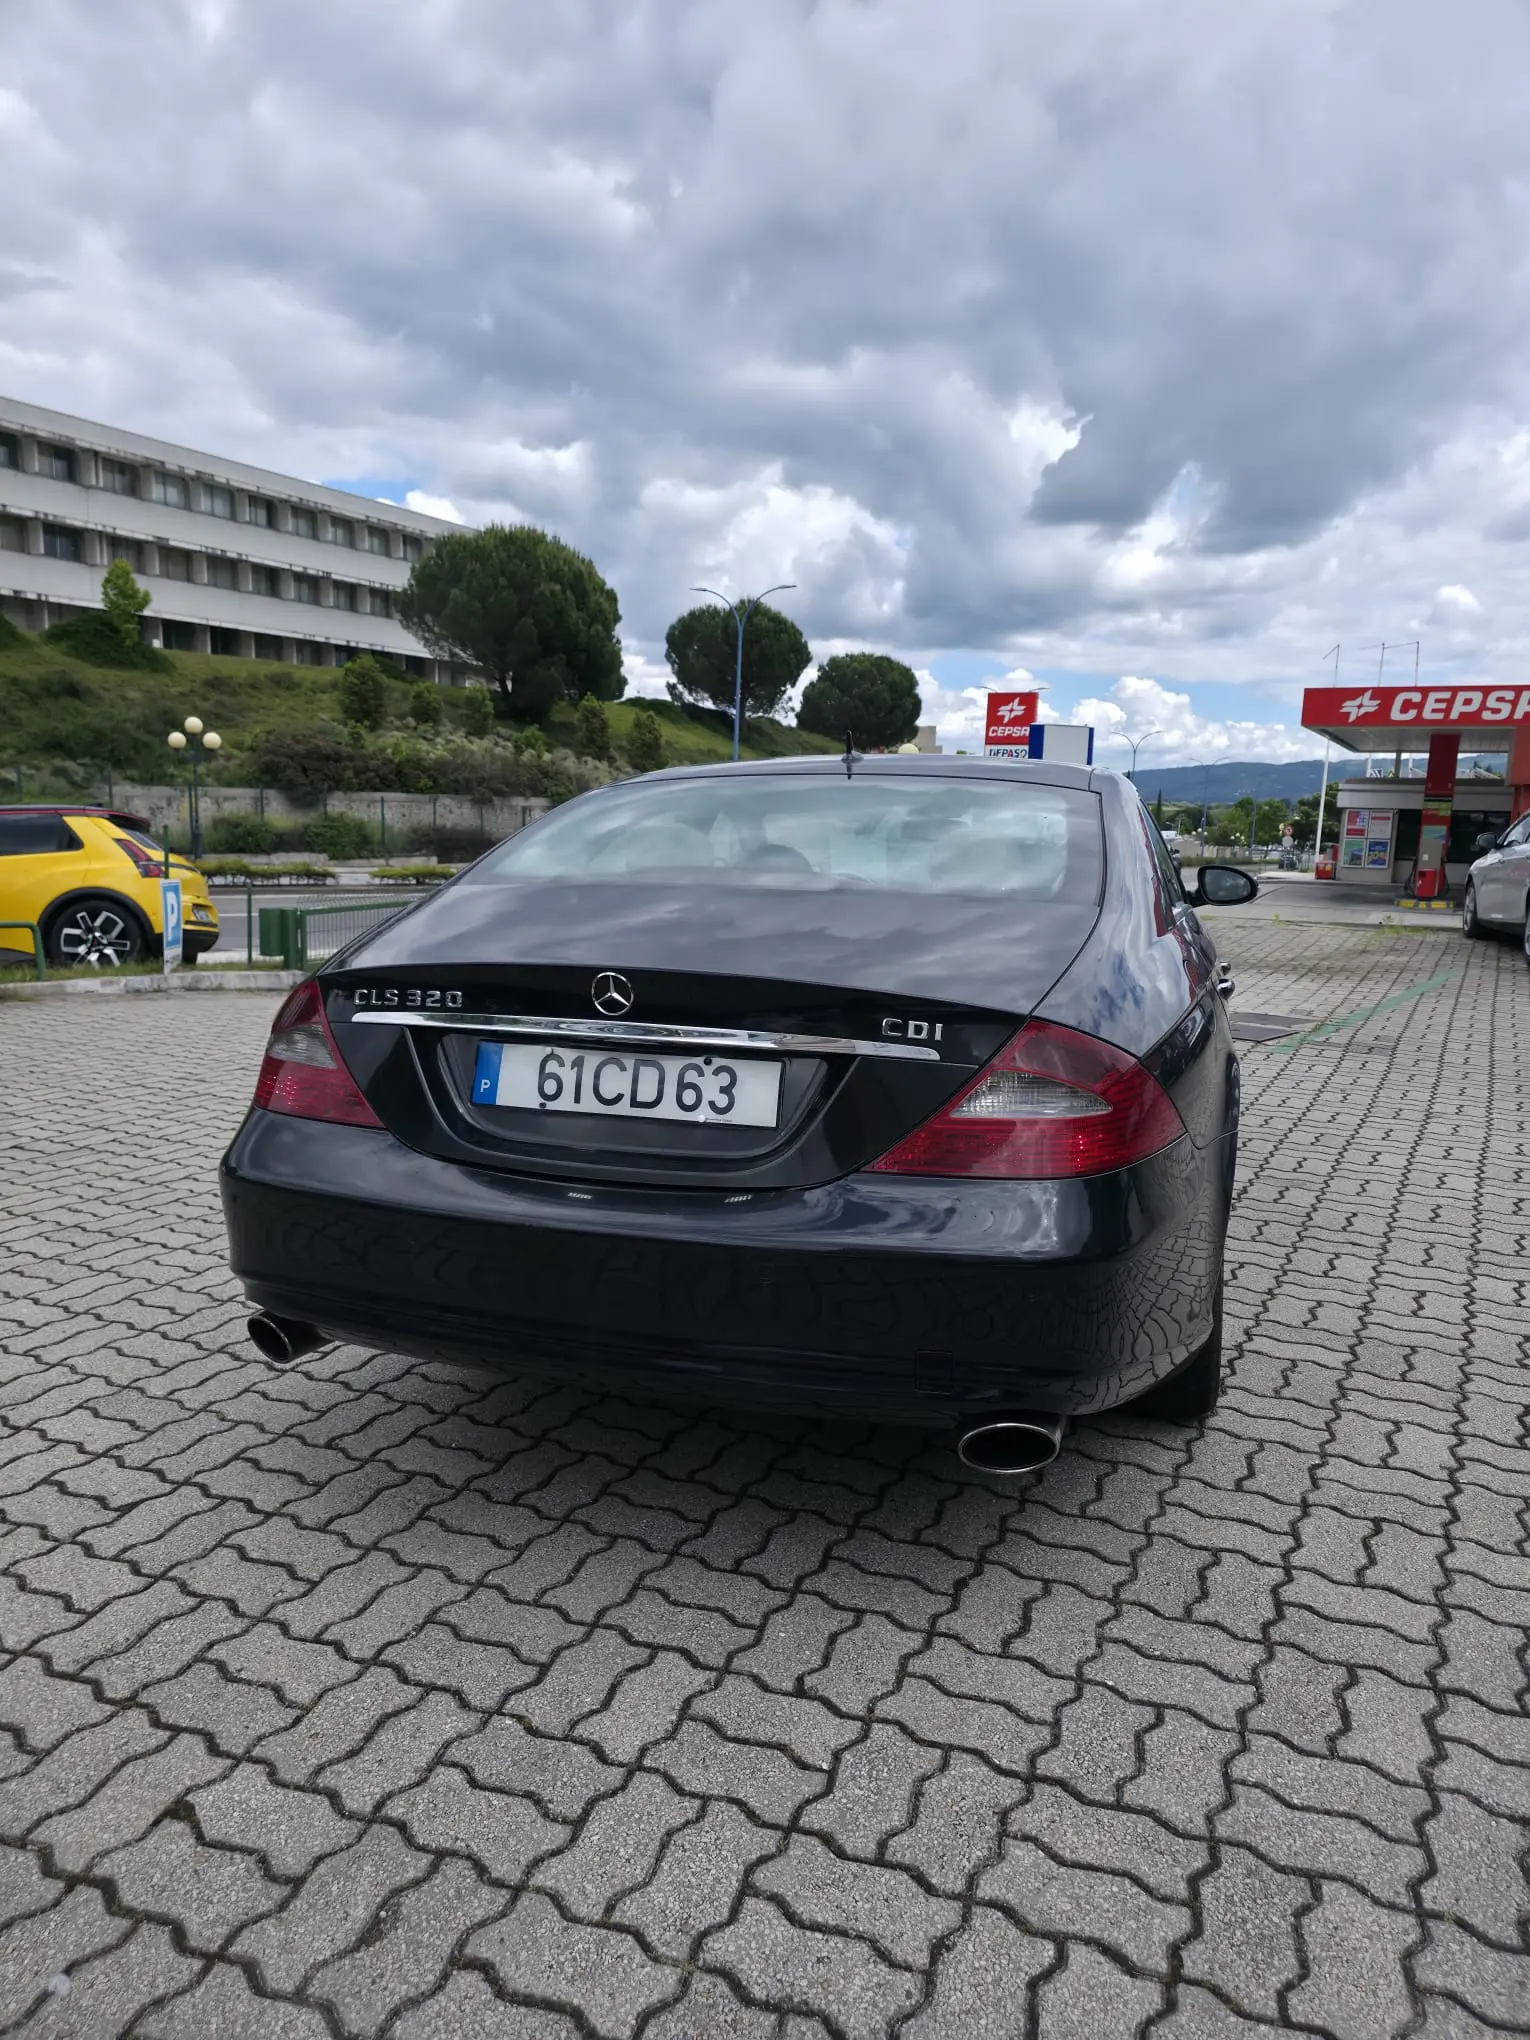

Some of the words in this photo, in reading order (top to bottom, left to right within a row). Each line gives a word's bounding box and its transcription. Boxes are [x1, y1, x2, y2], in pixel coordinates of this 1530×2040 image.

[988, 726, 1030, 737] CEPSA
[165, 891, 178, 941] P
[354, 989, 399, 1006] CLS
[406, 989, 463, 1008] 320
[882, 1017, 943, 1041] CDI
[480, 1079, 490, 1093] P
